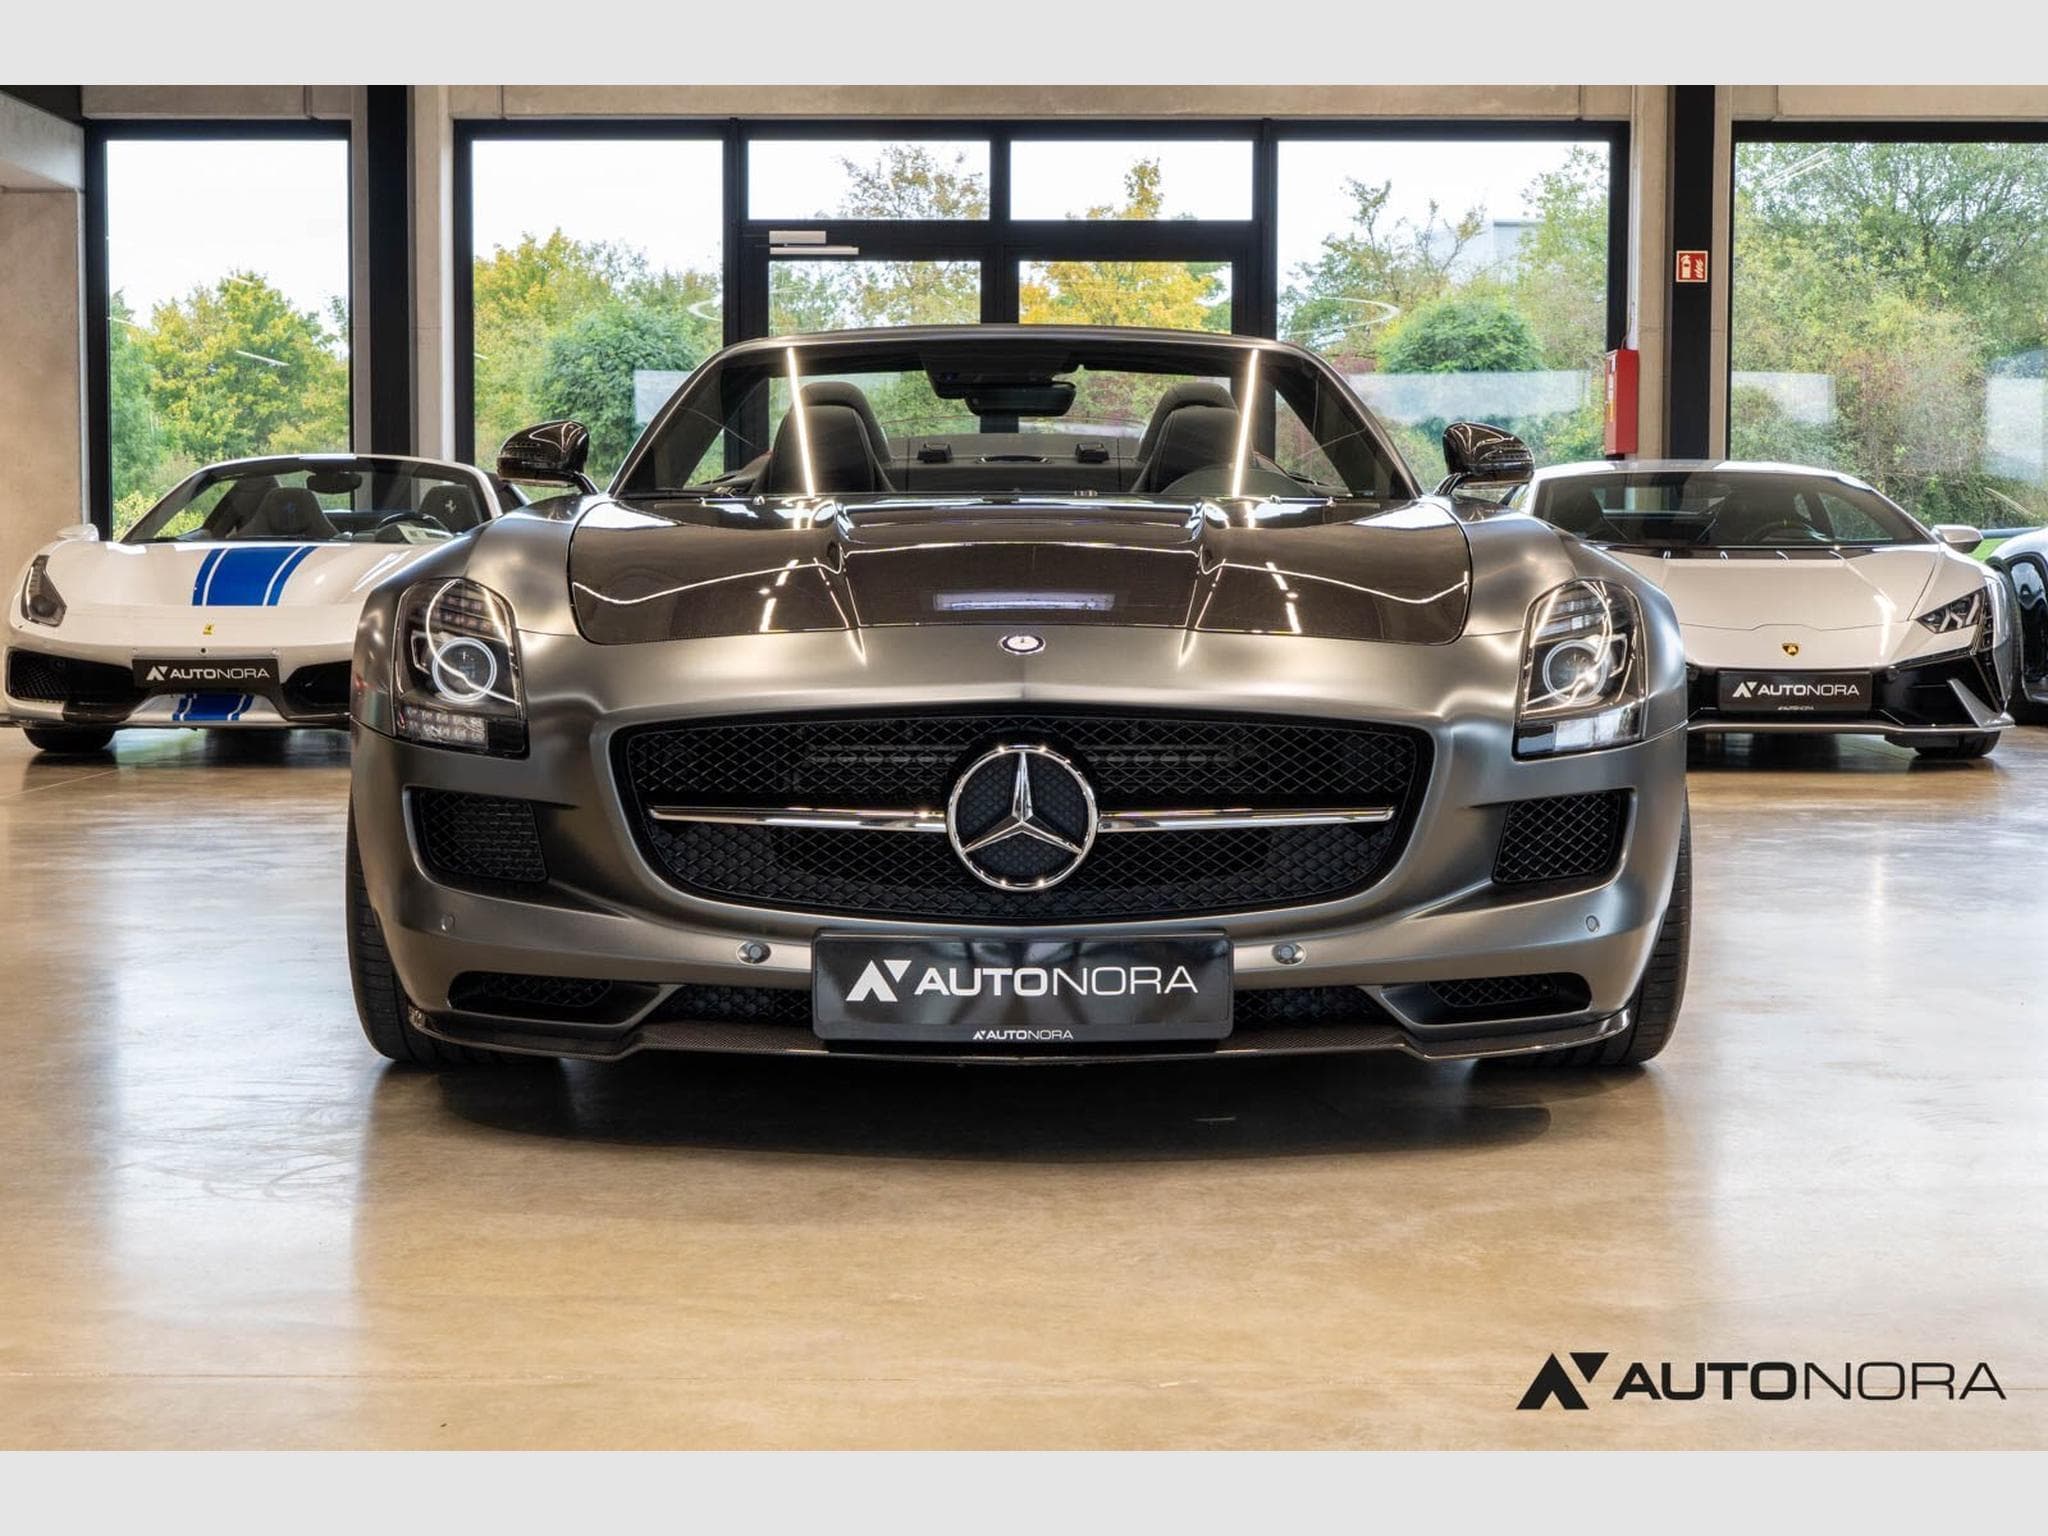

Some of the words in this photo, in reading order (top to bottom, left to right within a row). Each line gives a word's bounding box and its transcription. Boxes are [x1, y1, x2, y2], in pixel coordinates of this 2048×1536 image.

[169, 667, 271, 680] AUTONORA
[1757, 683, 1860, 696] AUTONORA
[914, 965, 1199, 996] AUTONORA
[985, 1029, 1074, 1040] AUTONORA
